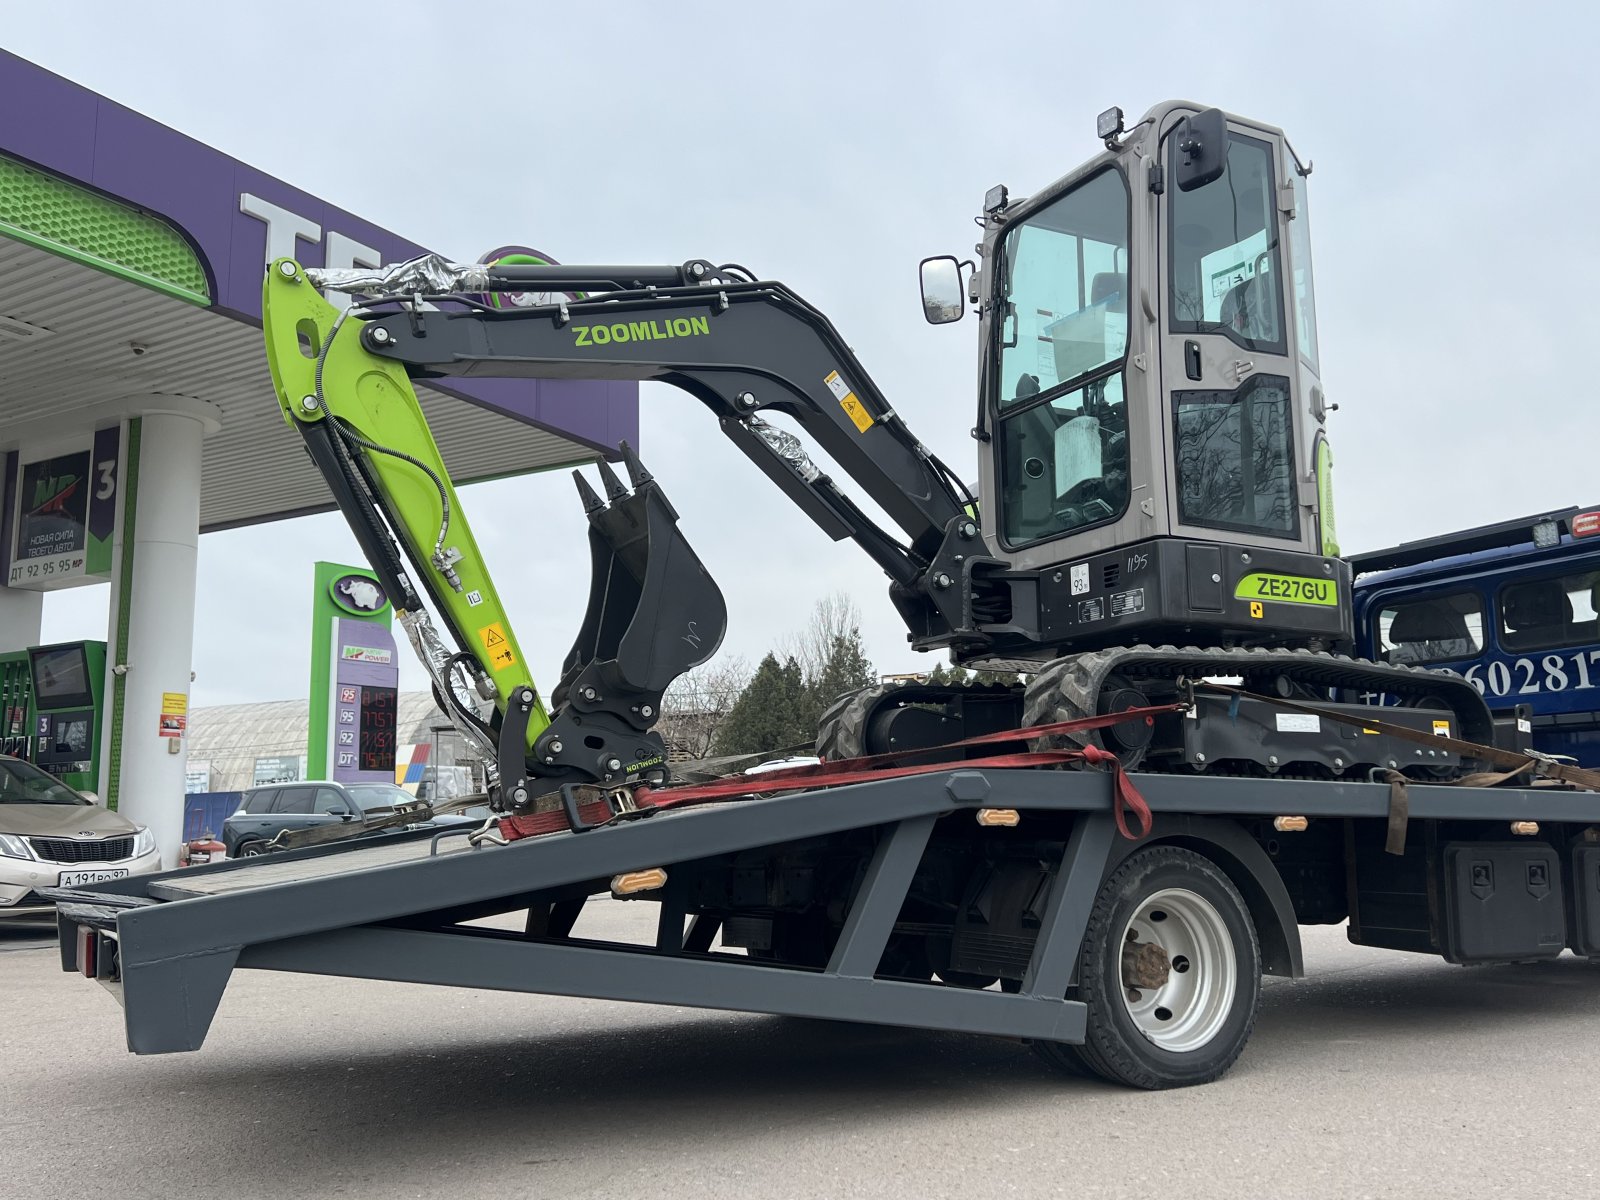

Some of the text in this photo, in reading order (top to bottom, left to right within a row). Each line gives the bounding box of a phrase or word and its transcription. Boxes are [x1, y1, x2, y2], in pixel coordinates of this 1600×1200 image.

[240, 193, 425, 316] TE
[571, 316, 710, 347] ZOOMLION
[96, 460, 115, 500] 3
[30, 530, 74, 545] НОВАЯ СИЛА
[28, 542, 75, 558] ТВОЕГО АВТО!
[10, 567, 23, 582] ДТ
[27, 565, 39, 577] 92
[42, 562, 54, 575] 95
[58, 559, 70, 572] 95
[1127, 553, 1149, 573] 1195
[1257, 577, 1327, 601] ZE27GU
[343, 690, 355, 700] 95
[342, 711, 354, 722] 95
[40, 718, 48, 733] 3
[341, 732, 354, 743] 92
[626, 756, 663, 773] ZOOMLION
